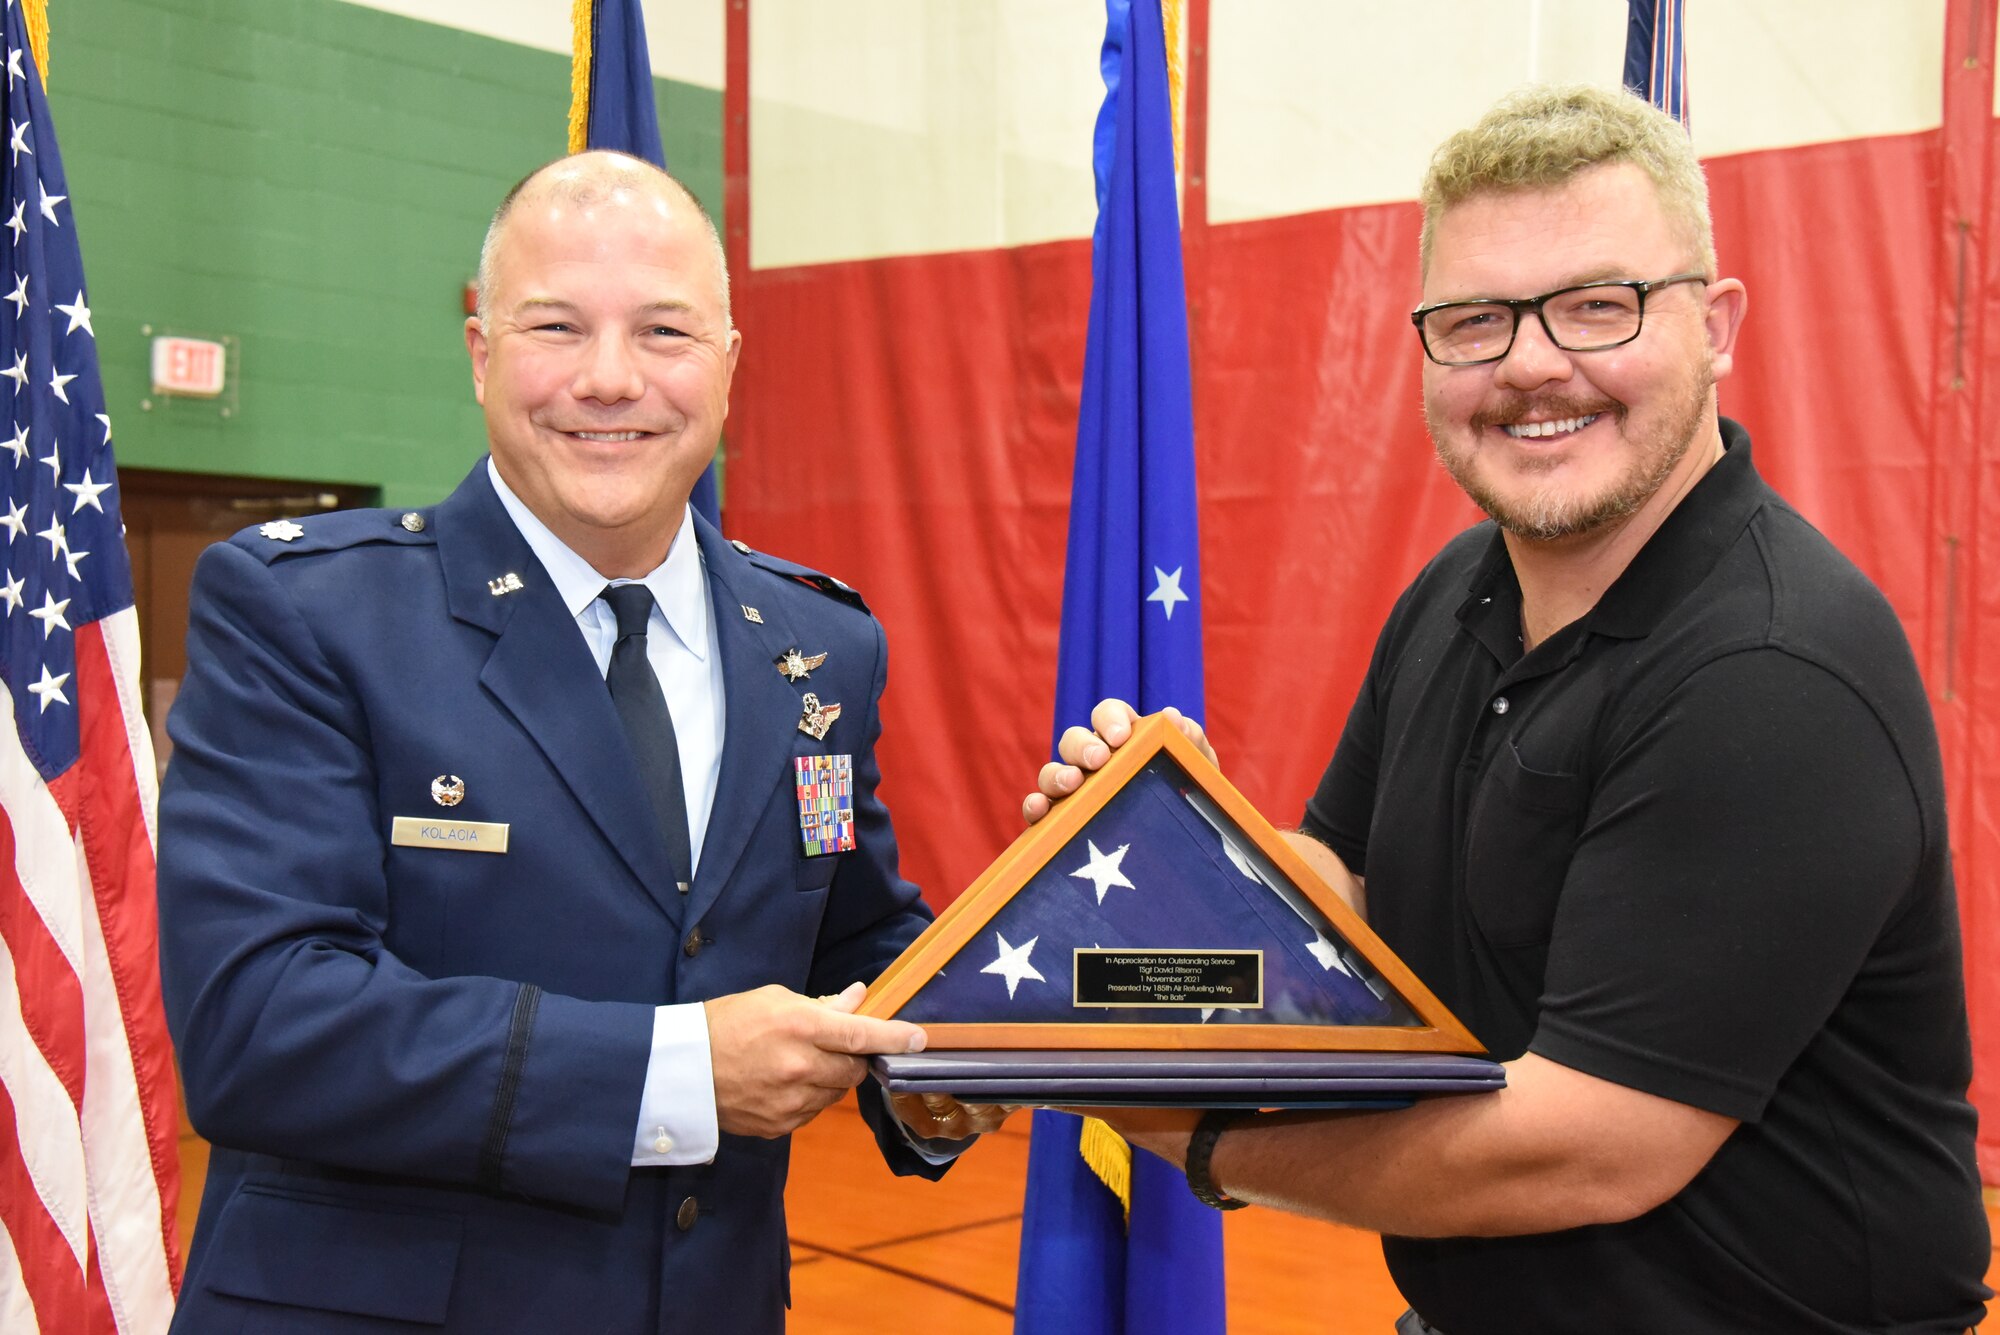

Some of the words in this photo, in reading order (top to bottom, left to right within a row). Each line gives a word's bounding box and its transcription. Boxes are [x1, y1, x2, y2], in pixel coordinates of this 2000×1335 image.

[167, 342, 217, 387] EXIT
[421, 827, 478, 842] KOLACIA
[1113, 957, 1157, 966] Appreciation
[1158, 957, 1167, 965] for
[1168, 957, 1209, 966] Outstanding
[1139, 966, 1153, 975] TSgt
[1154, 966, 1174, 974] David
[1146, 975, 1182, 983] November
[1107, 984, 1141, 992] Presented
[1142, 984, 1152, 992] by
[1153, 984, 1172, 992] 185th
[1183, 985, 1215, 993] Refueling
[1216, 986, 1233, 994] Wing
